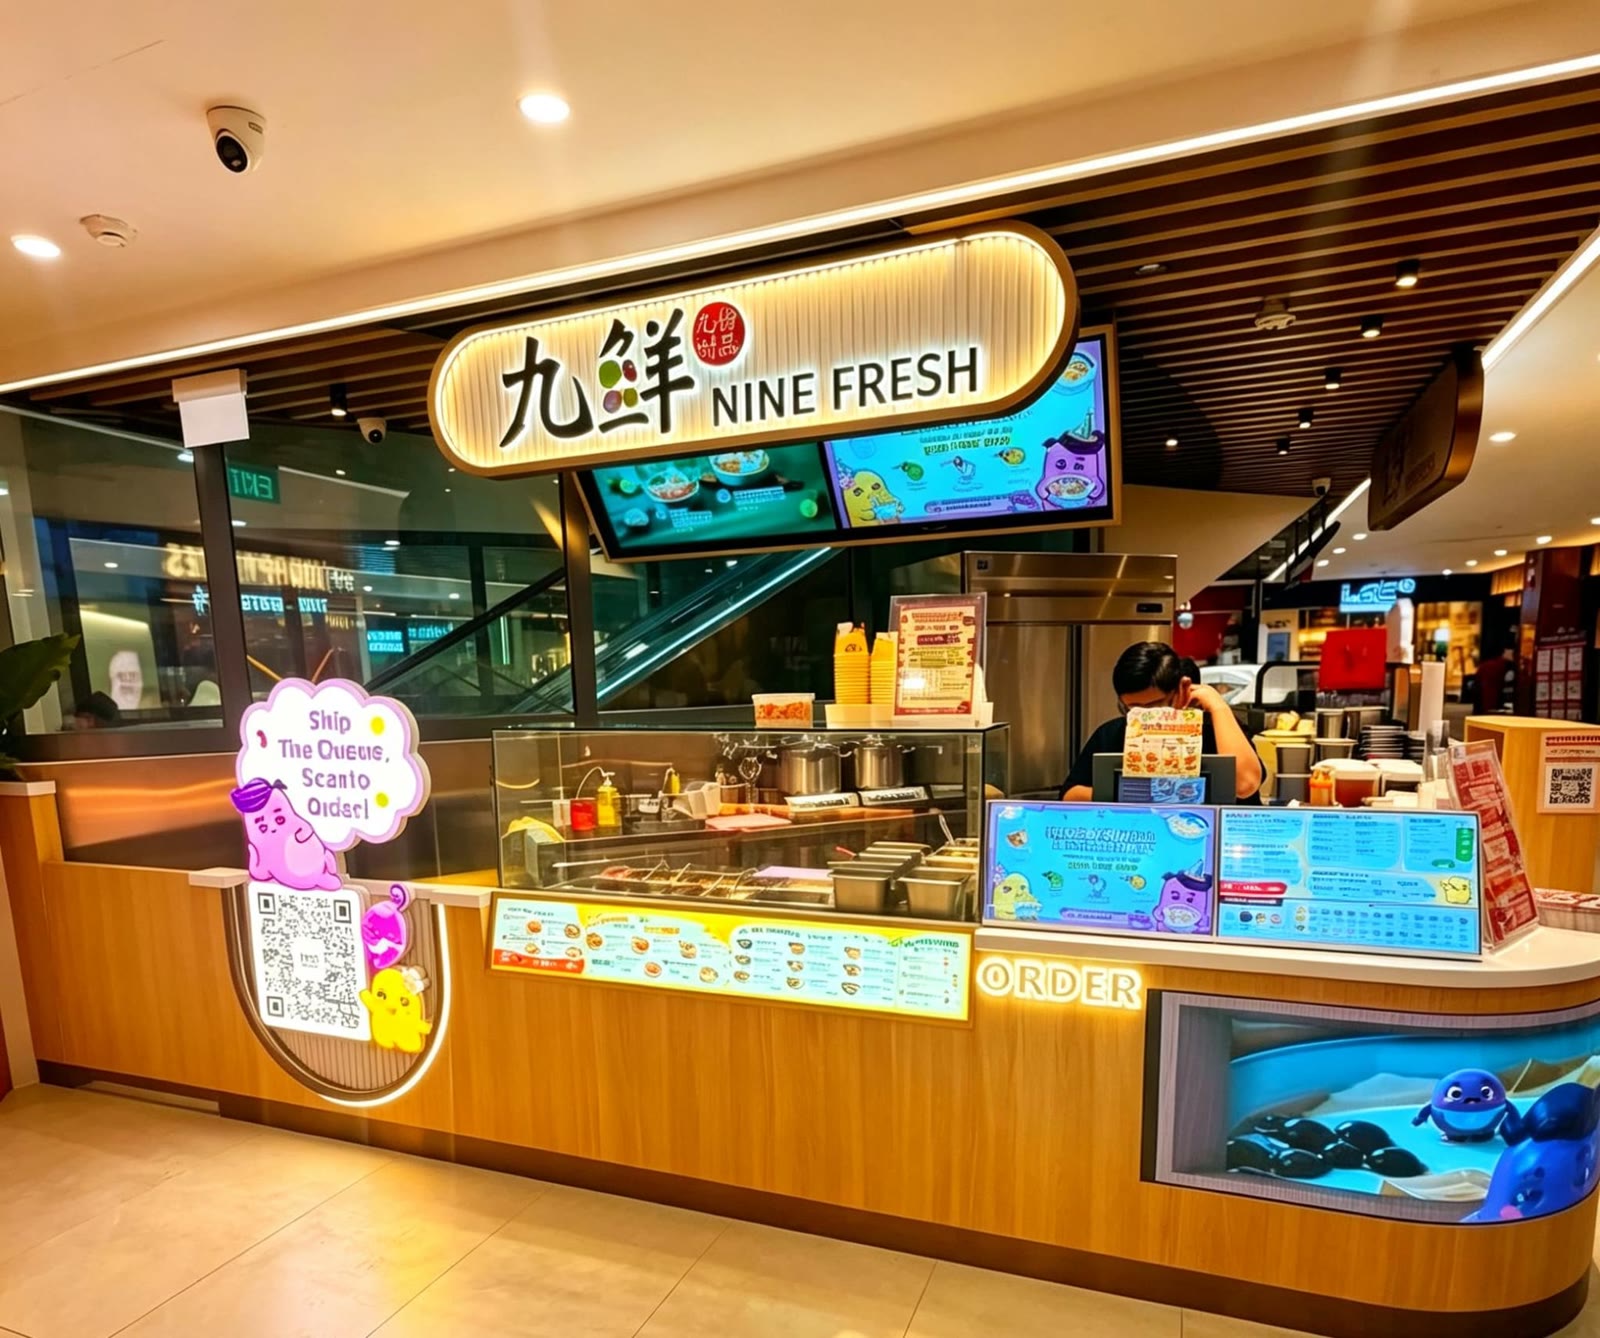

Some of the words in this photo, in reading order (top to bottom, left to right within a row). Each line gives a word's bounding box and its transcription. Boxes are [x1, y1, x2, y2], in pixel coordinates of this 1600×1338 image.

[712, 372, 816, 427] NINE
[833, 347, 978, 411] FRESH
[277, 739, 313, 760] The
[979, 959, 1138, 1006] ORDER
